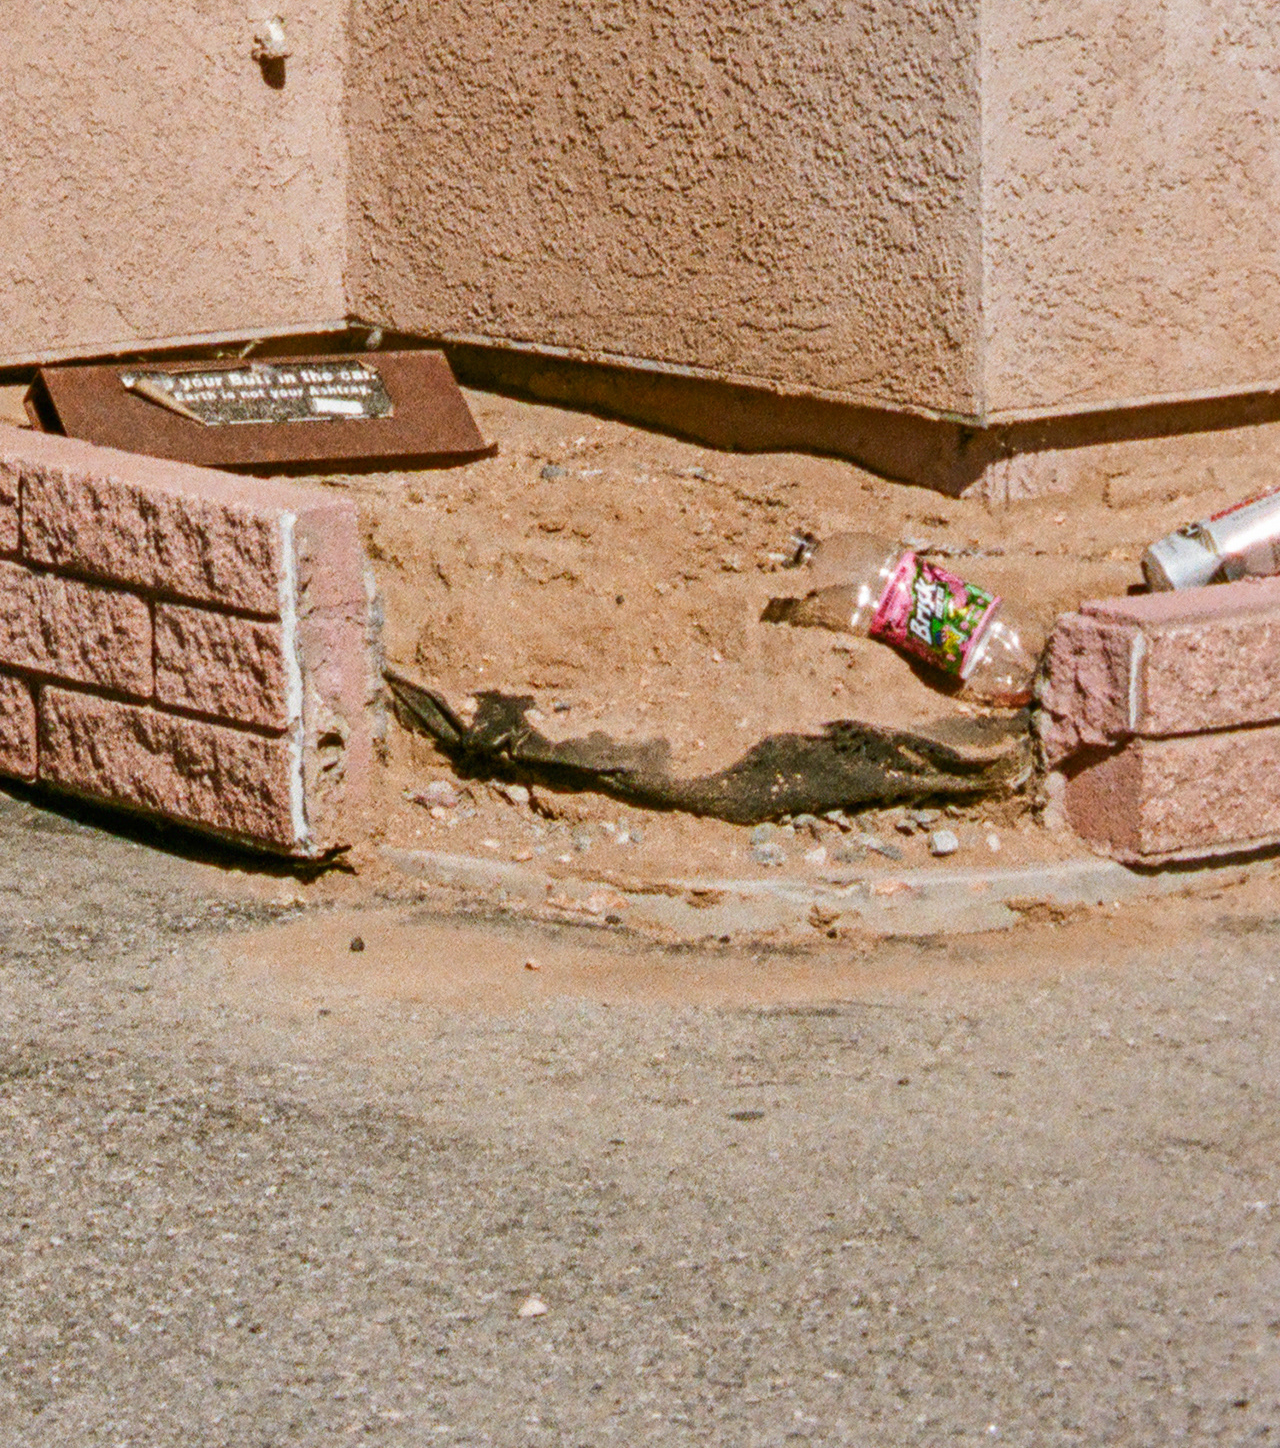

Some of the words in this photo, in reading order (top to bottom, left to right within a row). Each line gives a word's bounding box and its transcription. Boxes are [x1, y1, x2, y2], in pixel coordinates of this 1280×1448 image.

[177, 376, 223, 392] your
[227, 372, 272, 387] Butt
[278, 370, 297, 385] in
[300, 369, 333, 383] the
[239, 387, 266, 400] not
[270, 388, 303, 401] your
